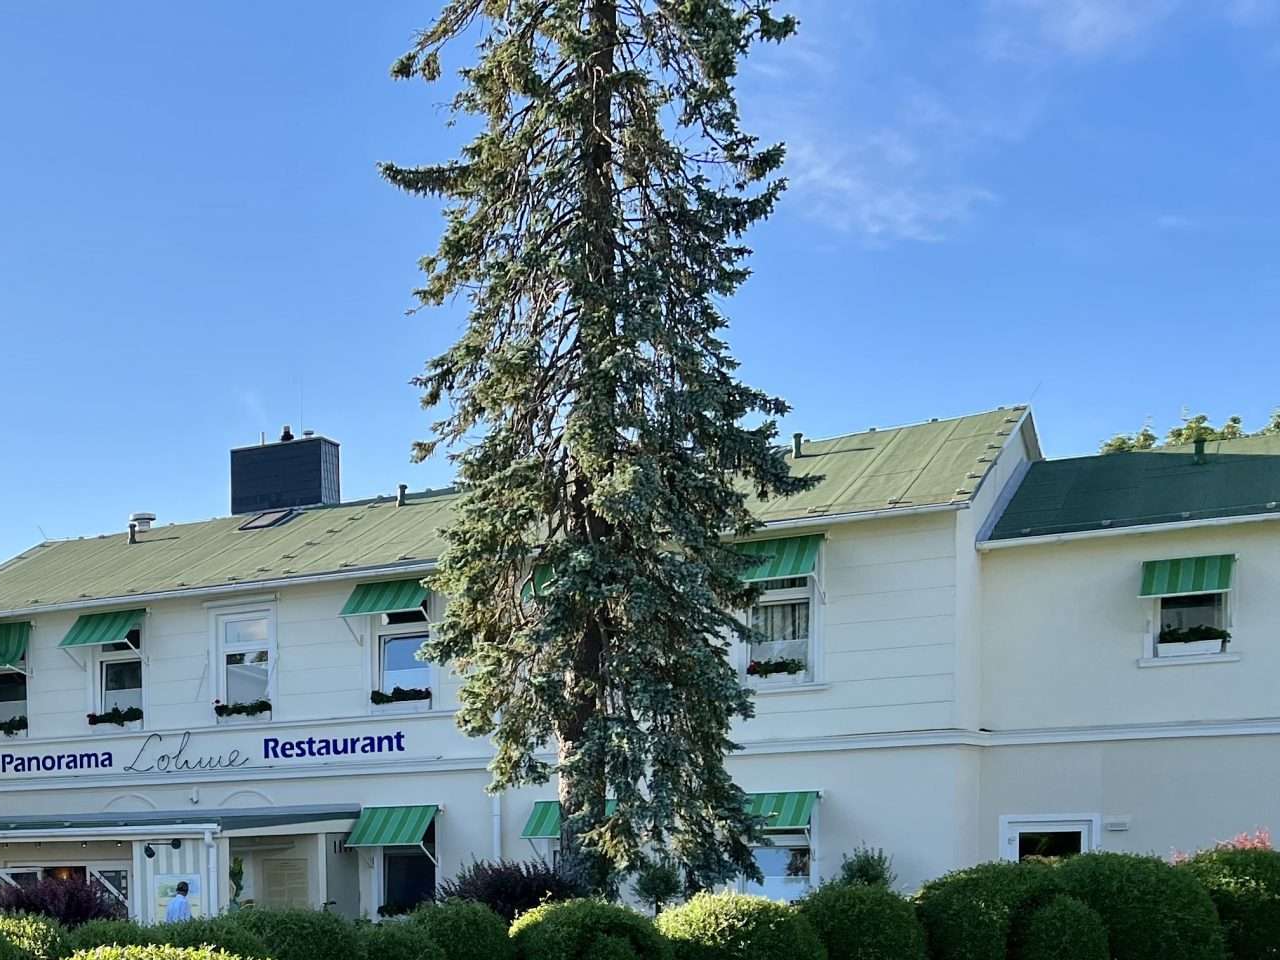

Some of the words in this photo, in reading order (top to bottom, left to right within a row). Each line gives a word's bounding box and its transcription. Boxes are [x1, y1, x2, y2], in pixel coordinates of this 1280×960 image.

[1, 751, 113, 773] Panorama
[123, 731, 250, 773] Lohme
[263, 731, 406, 760] Restaurant
